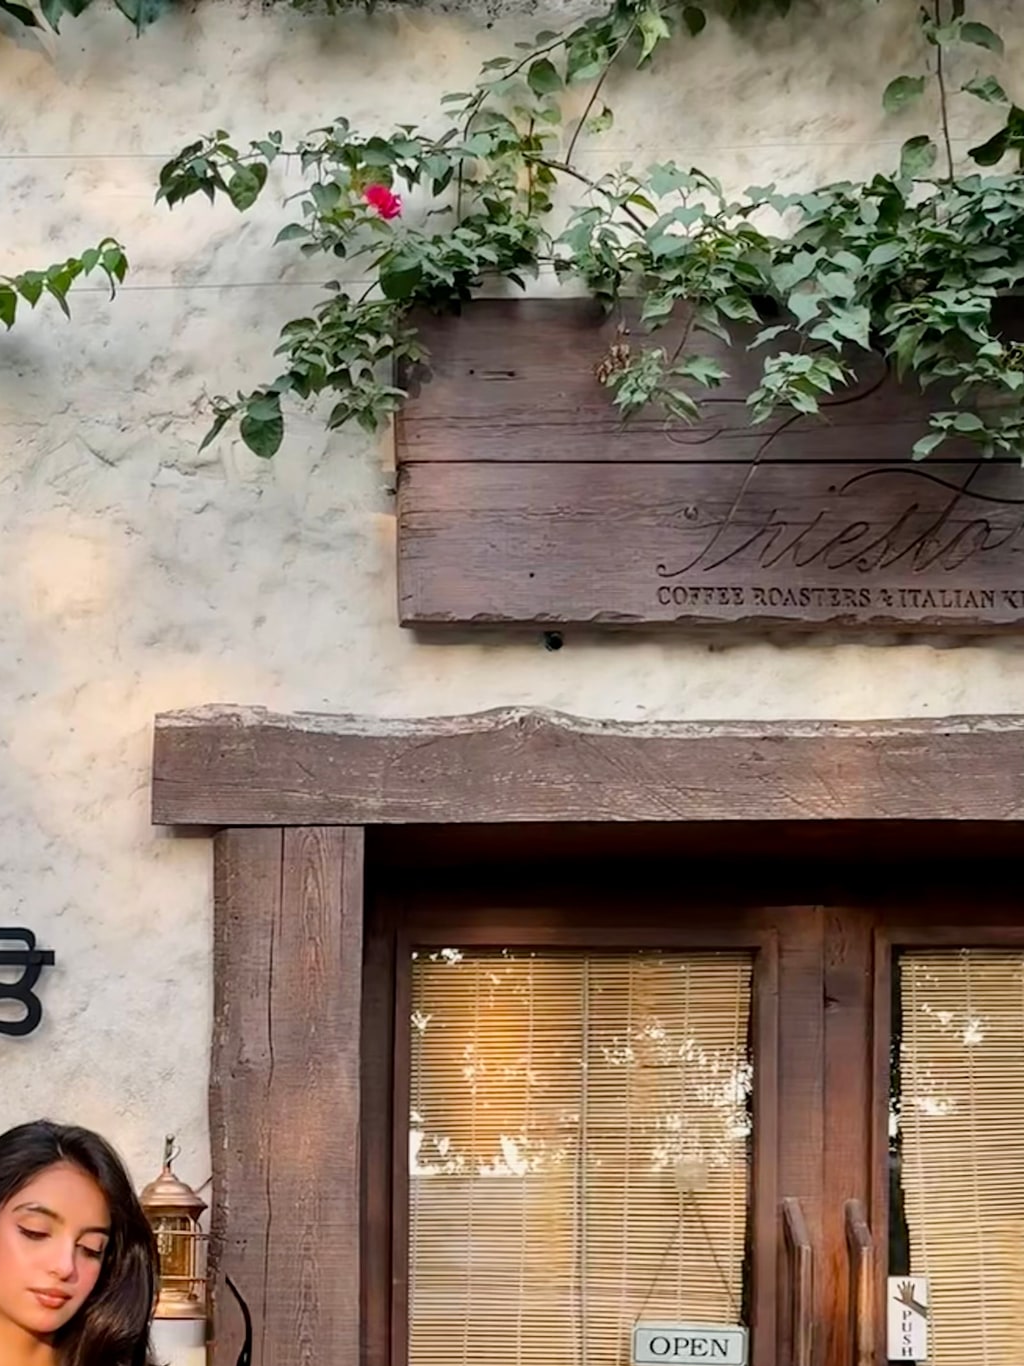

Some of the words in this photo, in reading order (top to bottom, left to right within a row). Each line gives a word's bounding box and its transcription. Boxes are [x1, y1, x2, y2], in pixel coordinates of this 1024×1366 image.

[656, 585, 745, 606] COFFEE
[751, 586, 871, 608] ROASTERS
[879, 588, 894, 608] &
[898, 588, 996, 609] ITALIAN
[901, 1310, 914, 1358] PUSH
[649, 1335, 730, 1358] OPEN
